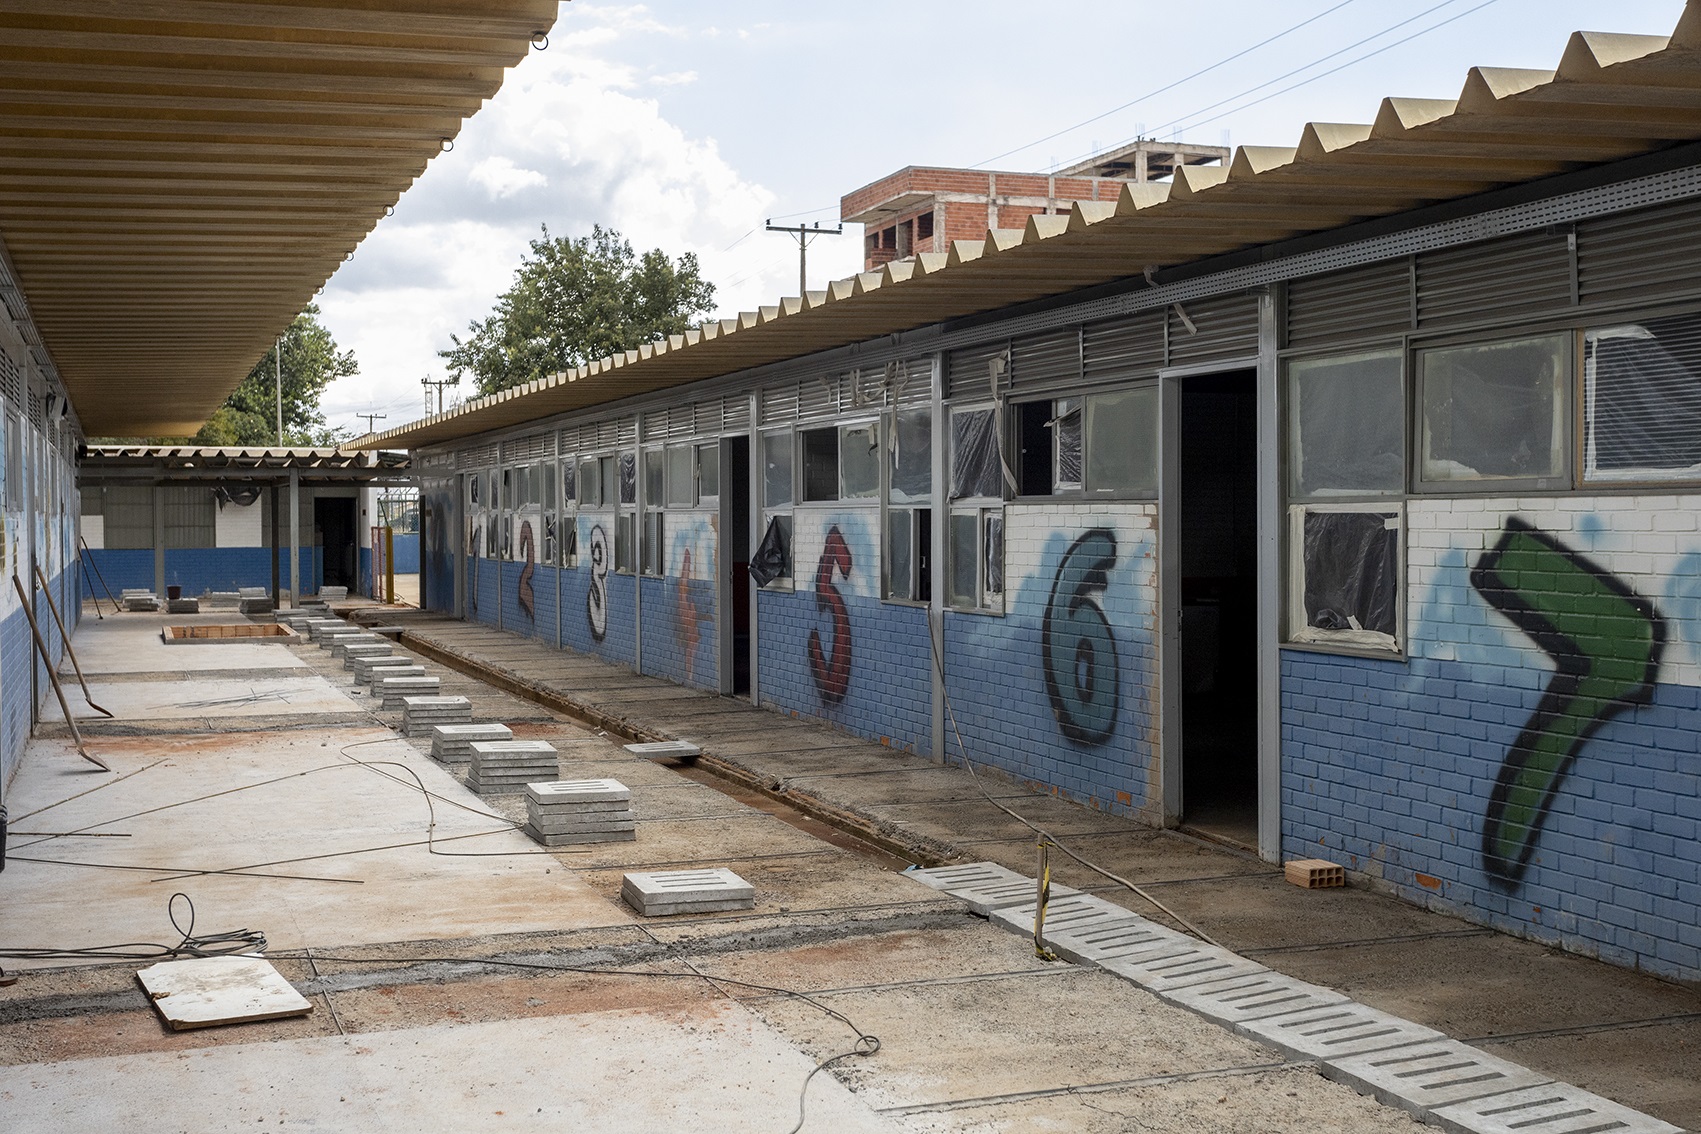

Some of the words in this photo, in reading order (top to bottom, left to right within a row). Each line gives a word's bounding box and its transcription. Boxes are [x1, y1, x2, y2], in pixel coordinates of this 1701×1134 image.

[518, 520, 535, 625] 2
[807, 524, 852, 704] 5
[1043, 525, 1119, 746] 6
[1470, 516, 1666, 891] 7
